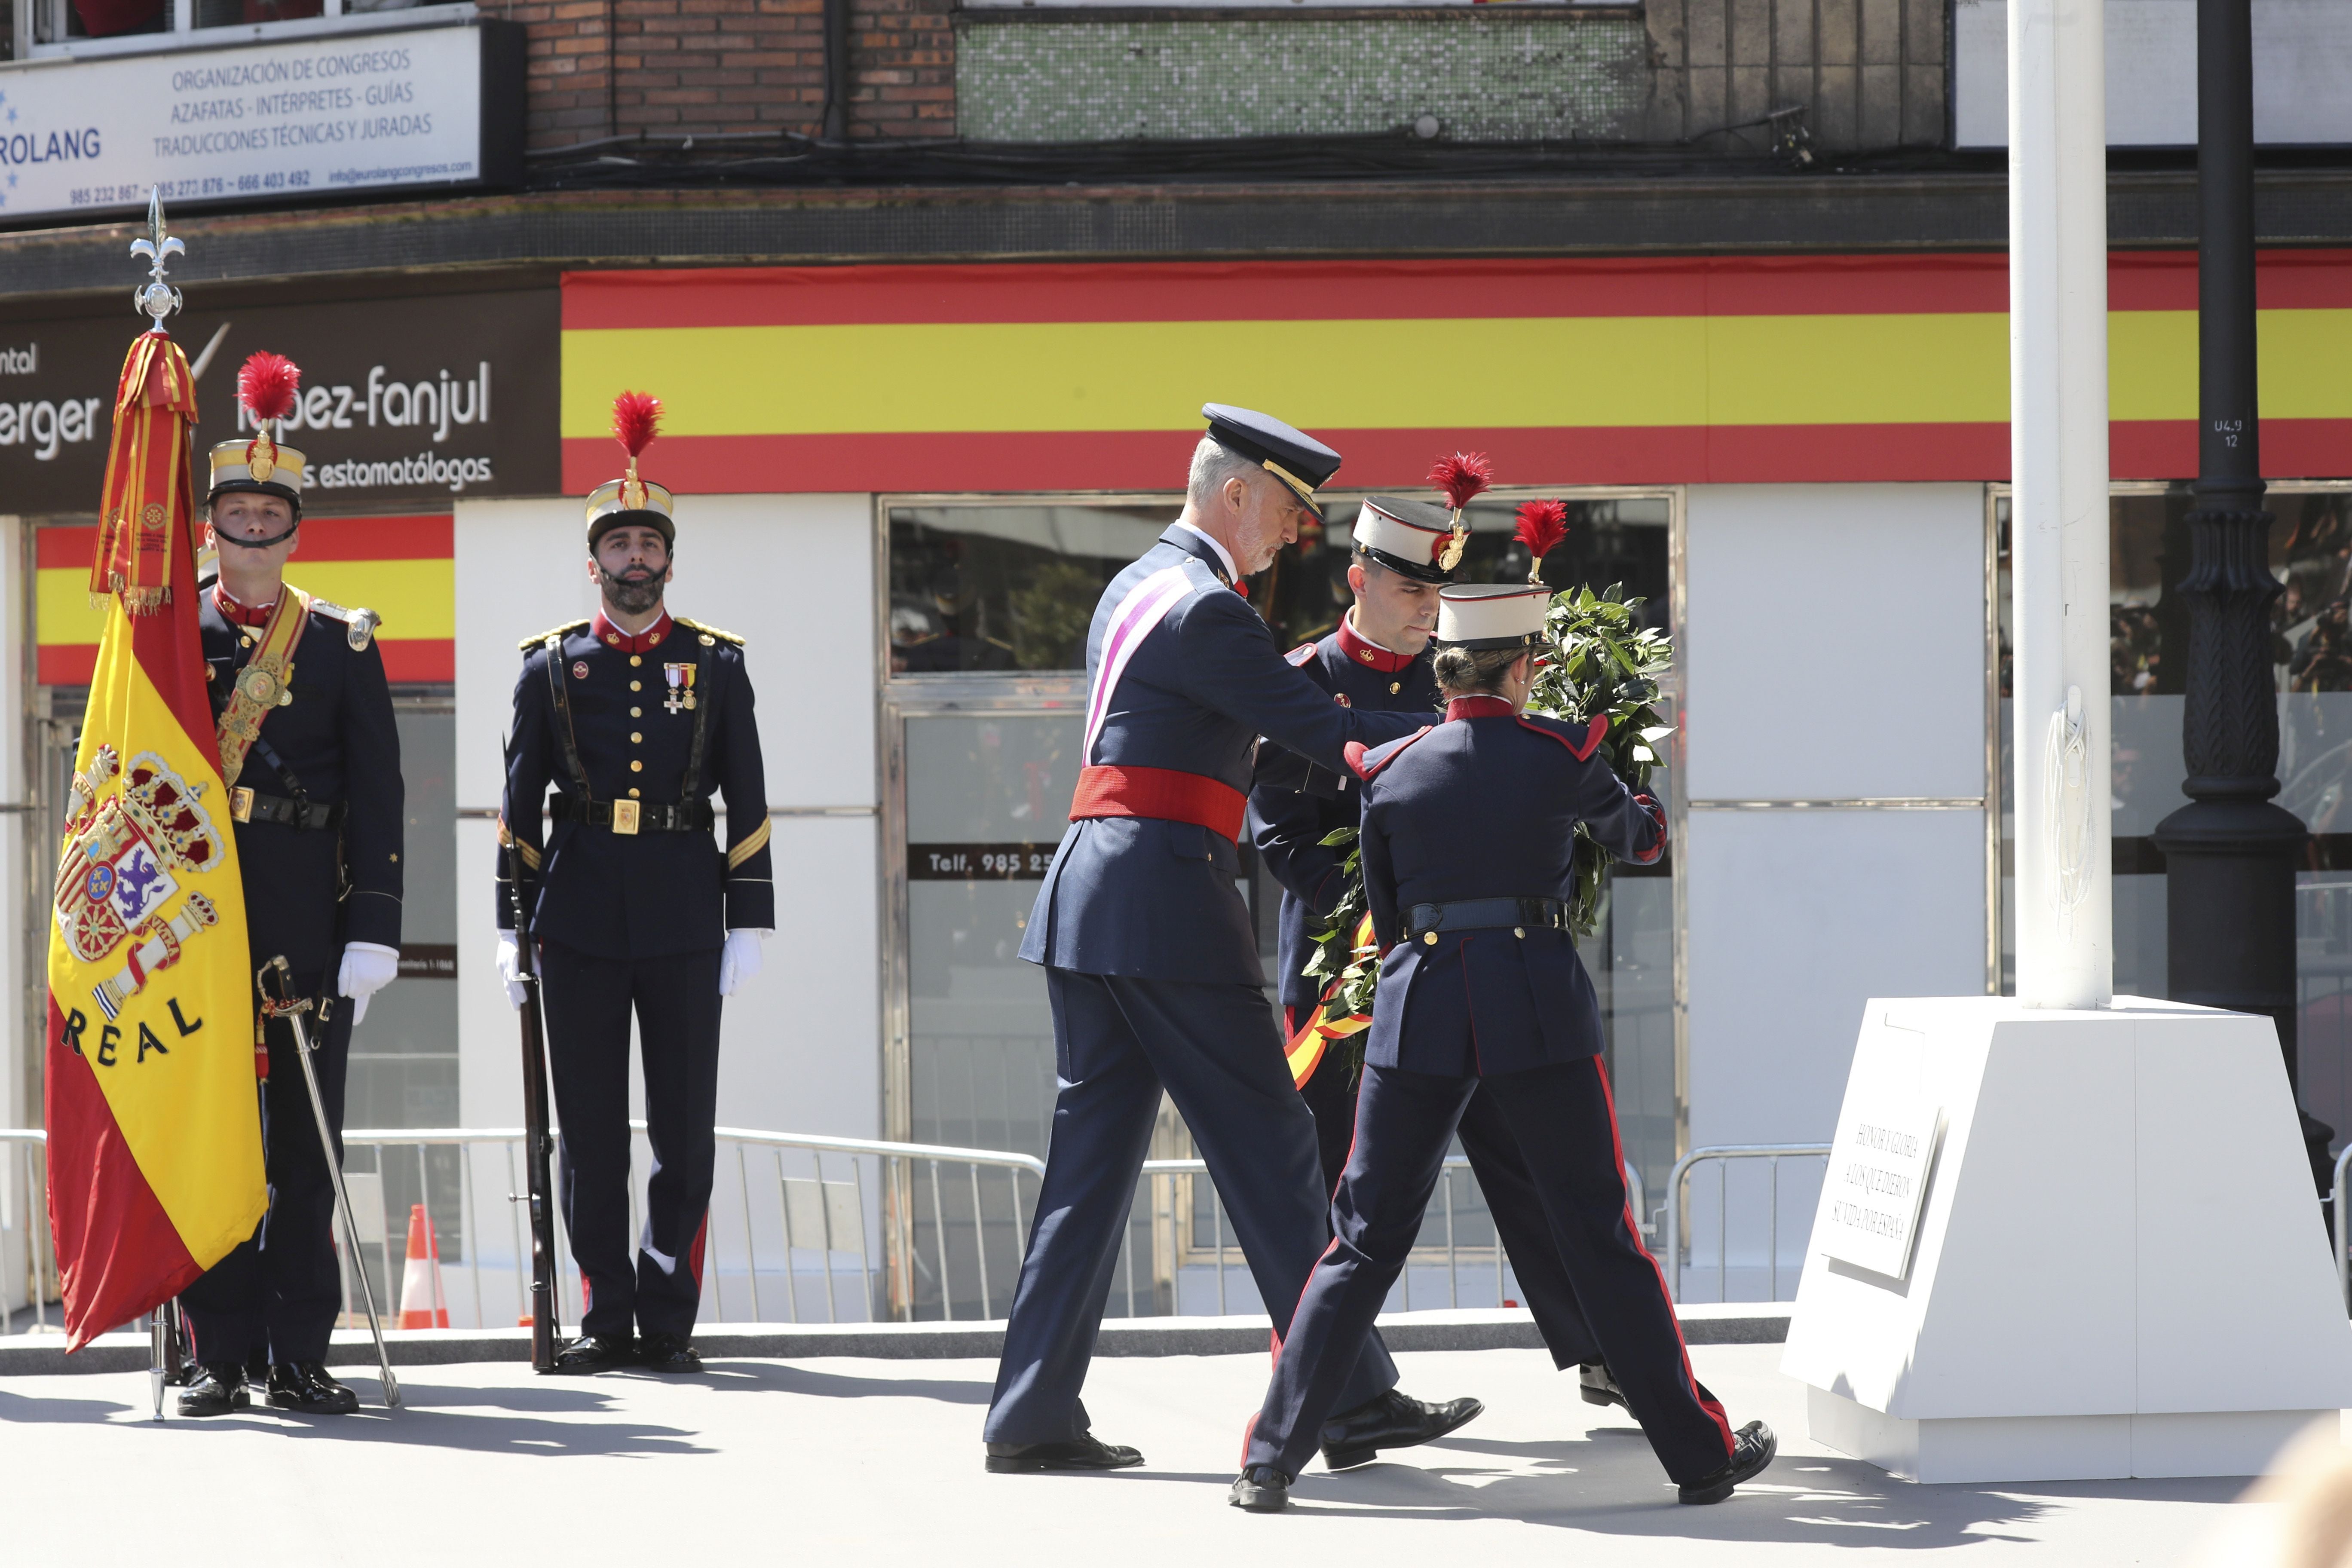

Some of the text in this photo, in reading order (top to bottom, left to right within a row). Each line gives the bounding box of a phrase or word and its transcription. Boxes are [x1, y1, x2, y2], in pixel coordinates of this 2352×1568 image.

[172, 49, 410, 92] ORGANIZACIÓN DE CONGRESOS
[171, 98, 243, 123] AZAFATAS
[257, 87, 353, 115] INTÉRPRETES
[365, 80, 413, 105] GUÍAS
[153, 113, 432, 157] TRADUCCIONES TÉCNICAS Y JURADAS
[238, 174, 259, 190] 666
[263, 172, 284, 188] 403
[289, 169, 311, 186] 492
[0, 398, 101, 461] erger
[2226, 435, 2237, 447] 12
[319, 451, 492, 491] estomatólogos
[929, 854, 973, 872] Telf.
[982, 854, 1021, 872] 985
[61, 997, 202, 1066] REAL
[1856, 1124, 1918, 1158] HONOR Y GLORIA
[1844, 1163, 1913, 1198] A LOS QUE DIERON
[1832, 1200, 1904, 1240] SU VIDA POR ESPAÑA
